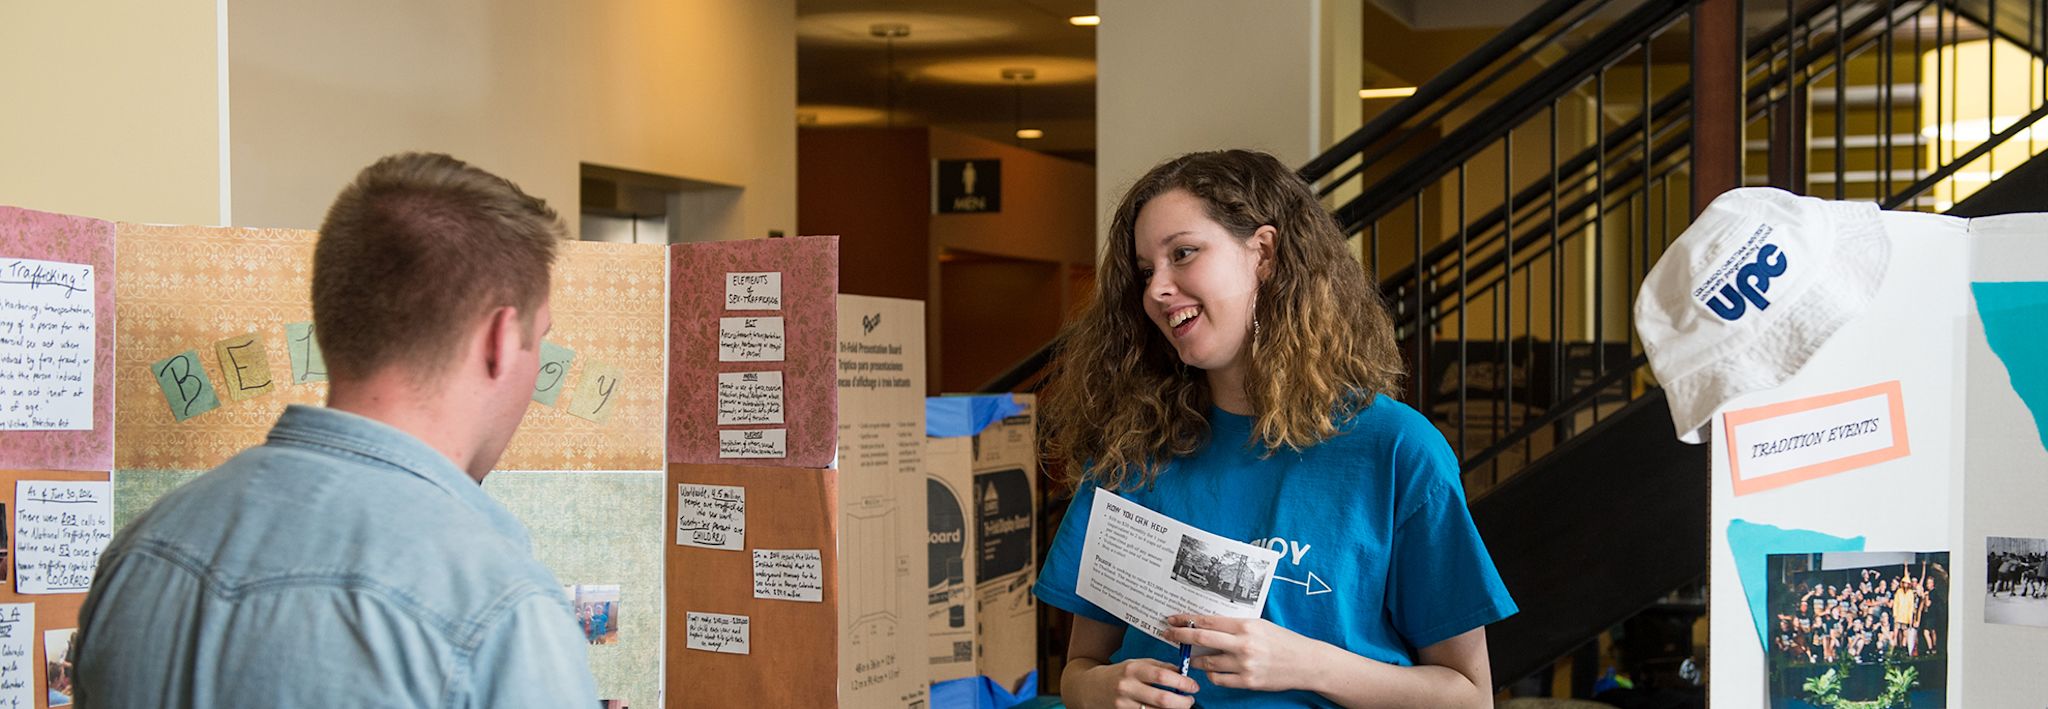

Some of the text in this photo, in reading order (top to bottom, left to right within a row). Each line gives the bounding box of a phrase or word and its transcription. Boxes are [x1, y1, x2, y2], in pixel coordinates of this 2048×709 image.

[1752, 418, 1879, 459] TRADITION EVENTS
[1106, 502, 1168, 535] HOW YOU CAN HELP
[1125, 612, 1140, 624] STOP
